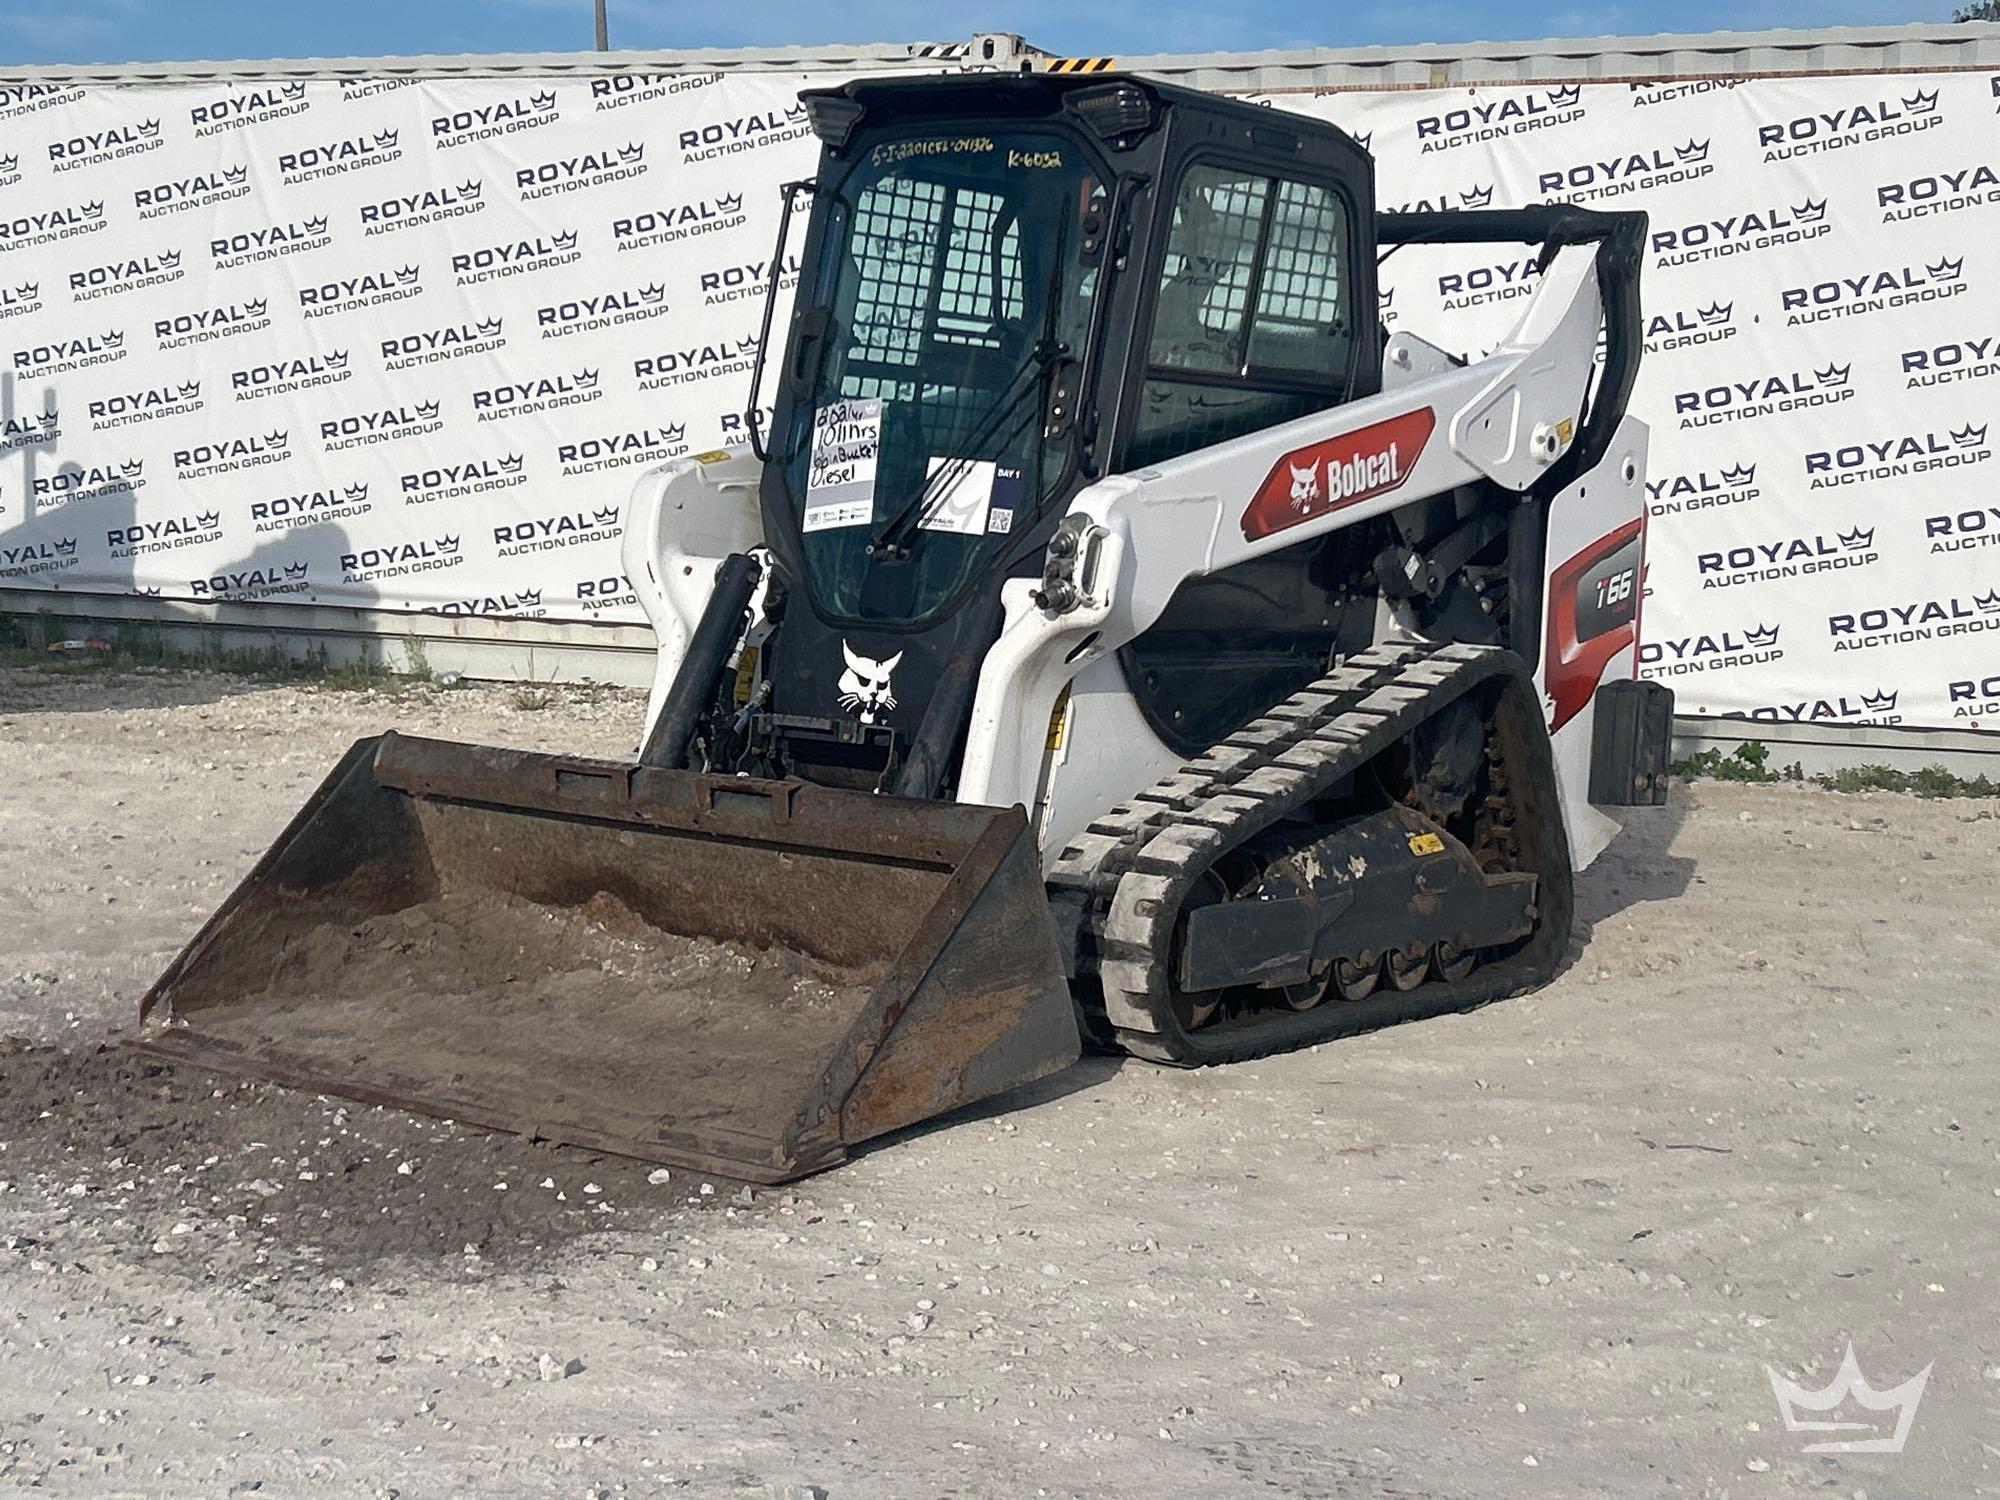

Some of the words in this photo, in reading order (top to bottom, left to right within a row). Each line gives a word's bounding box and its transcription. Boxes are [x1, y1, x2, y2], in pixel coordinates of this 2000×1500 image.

[38, 90, 86, 109] GROUP
[191, 90, 282, 125] ROYAL
[596, 87, 665, 112] AUCTION
[195, 114, 257, 138] AUCTION
[259, 102, 310, 122] GROUP
[432, 100, 531, 136] ROYAL
[436, 126, 503, 150] AUCTION
[506, 112, 559, 133] GROUP
[679, 112, 785, 150] ROYAL
[1417, 95, 1547, 139] ROYAL
[1421, 125, 1509, 155] AUCTION
[1514, 109, 1585, 133] GROUP
[1759, 102, 1901, 147] ROYAL
[48, 127, 138, 160] ROYAL
[279, 138, 374, 173] ROYAL
[684, 139, 755, 164] AUCTION
[1763, 133, 1860, 163] AUCTION
[1865, 116, 1943, 141] GROUP
[53, 152, 113, 174] AUCTION
[116, 139, 163, 158] GROUP
[284, 163, 348, 186] AUCTION
[351, 150, 402, 170] GROUP
[516, 152, 618, 188] ROYAL
[1539, 150, 1674, 194] ROYAL
[135, 173, 224, 207] ROYAL
[521, 178, 589, 201] AUCTION
[592, 165, 647, 185] GROUP
[1545, 180, 1636, 206] AUCTION
[1640, 165, 1713, 189] GROUP
[1877, 166, 2000, 207] ROYA
[139, 198, 199, 220] AUCTION
[202, 186, 250, 205] GROUP
[360, 188, 457, 223] ROYAL
[365, 214, 430, 236] AUCTION
[433, 202, 485, 221] GROUP
[1882, 193, 1982, 224] AUCTION
[60, 221, 107, 239] GROUP
[613, 202, 716, 238] ROYAL
[618, 228, 687, 252] AUCTION
[691, 215, 746, 236] GROUP
[1652, 209, 1791, 253] ROYAL
[210, 224, 304, 257] ROYAL
[216, 249, 277, 270] AUCTION
[280, 237, 331, 255] GROUP
[452, 238, 552, 273] ROYAL
[1657, 241, 1751, 269] AUCTION
[1755, 225, 1831, 248] GROUP
[69, 258, 158, 290] ROYAL
[457, 264, 524, 286] AUCTION
[527, 252, 581, 271] GROUP
[1438, 258, 1540, 296] ROYA
[74, 282, 133, 303] AUCTION
[136, 270, 184, 288] GROUP
[299, 273, 395, 306] ROYAL
[304, 298, 368, 319] AUCTION
[371, 286, 423, 305] GROUP
[1443, 284, 1532, 311] AUCTION
[1782, 268, 1925, 311] ROYAL
[538, 292, 639, 326] ROYAL
[1787, 298, 1884, 327] AUCTION
[1889, 283, 1967, 307] GROUP
[155, 306, 245, 338] ROYAL
[159, 330, 219, 351] AUCTION
[222, 319, 270, 336] GROUP
[542, 317, 610, 339] AUCTION
[614, 305, 668, 324] GROUP
[1663, 327, 1736, 350] GROUP
[13, 337, 102, 368] ROYAL
[381, 325, 477, 358] ROYAL
[386, 350, 451, 371] AUCTION
[454, 339, 506, 357] GROUP
[18, 361, 77, 380] AUCTION
[80, 350, 127, 367] GROUP
[232, 357, 324, 389] ROYAL
[634, 343, 737, 377] ROYAL
[639, 369, 708, 391] AUCTION
[711, 359, 757, 377] GROU
[89, 388, 178, 418] ROYAL
[236, 381, 298, 402] AUCTION
[301, 371, 352, 388] GROUP
[473, 376, 573, 409] ROYAL
[1675, 373, 1814, 414] ROYAL
[93, 411, 153, 431] AUCTION
[155, 401, 203, 418] GROUP
[478, 401, 545, 422] AUCTION
[548, 390, 602, 408] GROUP
[1680, 403, 1773, 430] AUCTION
[1779, 389, 1854, 412] GROUP
[15, 430, 62, 447] GROUP
[321, 407, 415, 439] ROYAL
[325, 432, 389, 452] AUCTION
[392, 421, 443, 439] GROUP
[173, 437, 264, 468] ROYAL
[558, 430, 660, 463] ROYAL
[563, 456, 631, 476] AUCTION
[634, 445, 688, 463] GROUP
[1805, 434, 1950, 474] ROYAL
[33, 464, 121, 495] ROYAL
[178, 461, 239, 480] AUCTION
[242, 451, 291, 468] GROUP
[401, 461, 498, 492] ROYAL
[1327, 442, 1398, 504] Bobcat
[1810, 464, 1908, 490] AUCTION
[1913, 450, 1991, 472] GROUP
[36, 488, 97, 508] AUCTION
[99, 479, 146, 496] GROUP
[251, 490, 344, 520] ROYAL
[405, 485, 471, 505] AUCTION
[474, 475, 527, 492] GROUP
[1686, 489, 1760, 510] GROUP
[107, 517, 197, 547] ROYAL
[255, 514, 318, 533] AUCTION
[321, 504, 371, 522] GROUP
[494, 513, 594, 544] ROYAL
[111, 541, 172, 559] AUCTION
[174, 531, 223, 548] GROUP
[340, 541, 436, 571] ROYAL
[498, 538, 565, 558] AUCTION
[568, 528, 622, 545] GROUP
[1698, 536, 1838, 574] ROYAL
[31, 557, 79, 573] GROUP
[190, 567, 282, 595] ROYAL
[343, 566, 409, 584] AUCTION
[412, 556, 463, 573] GROUP
[1703, 565, 1797, 590] AUCTION
[1802, 553, 1878, 574] GROUP
[261, 582, 310, 597] GROUP
[1829, 599, 1973, 636] ROYAL
[1639, 633, 1745, 662] OYAL
[1834, 628, 1931, 652] AUCTION
[1937, 618, 2000, 637] GROU
[1640, 661, 1704, 679] CTION
[1709, 650, 1783, 670] GROUP
